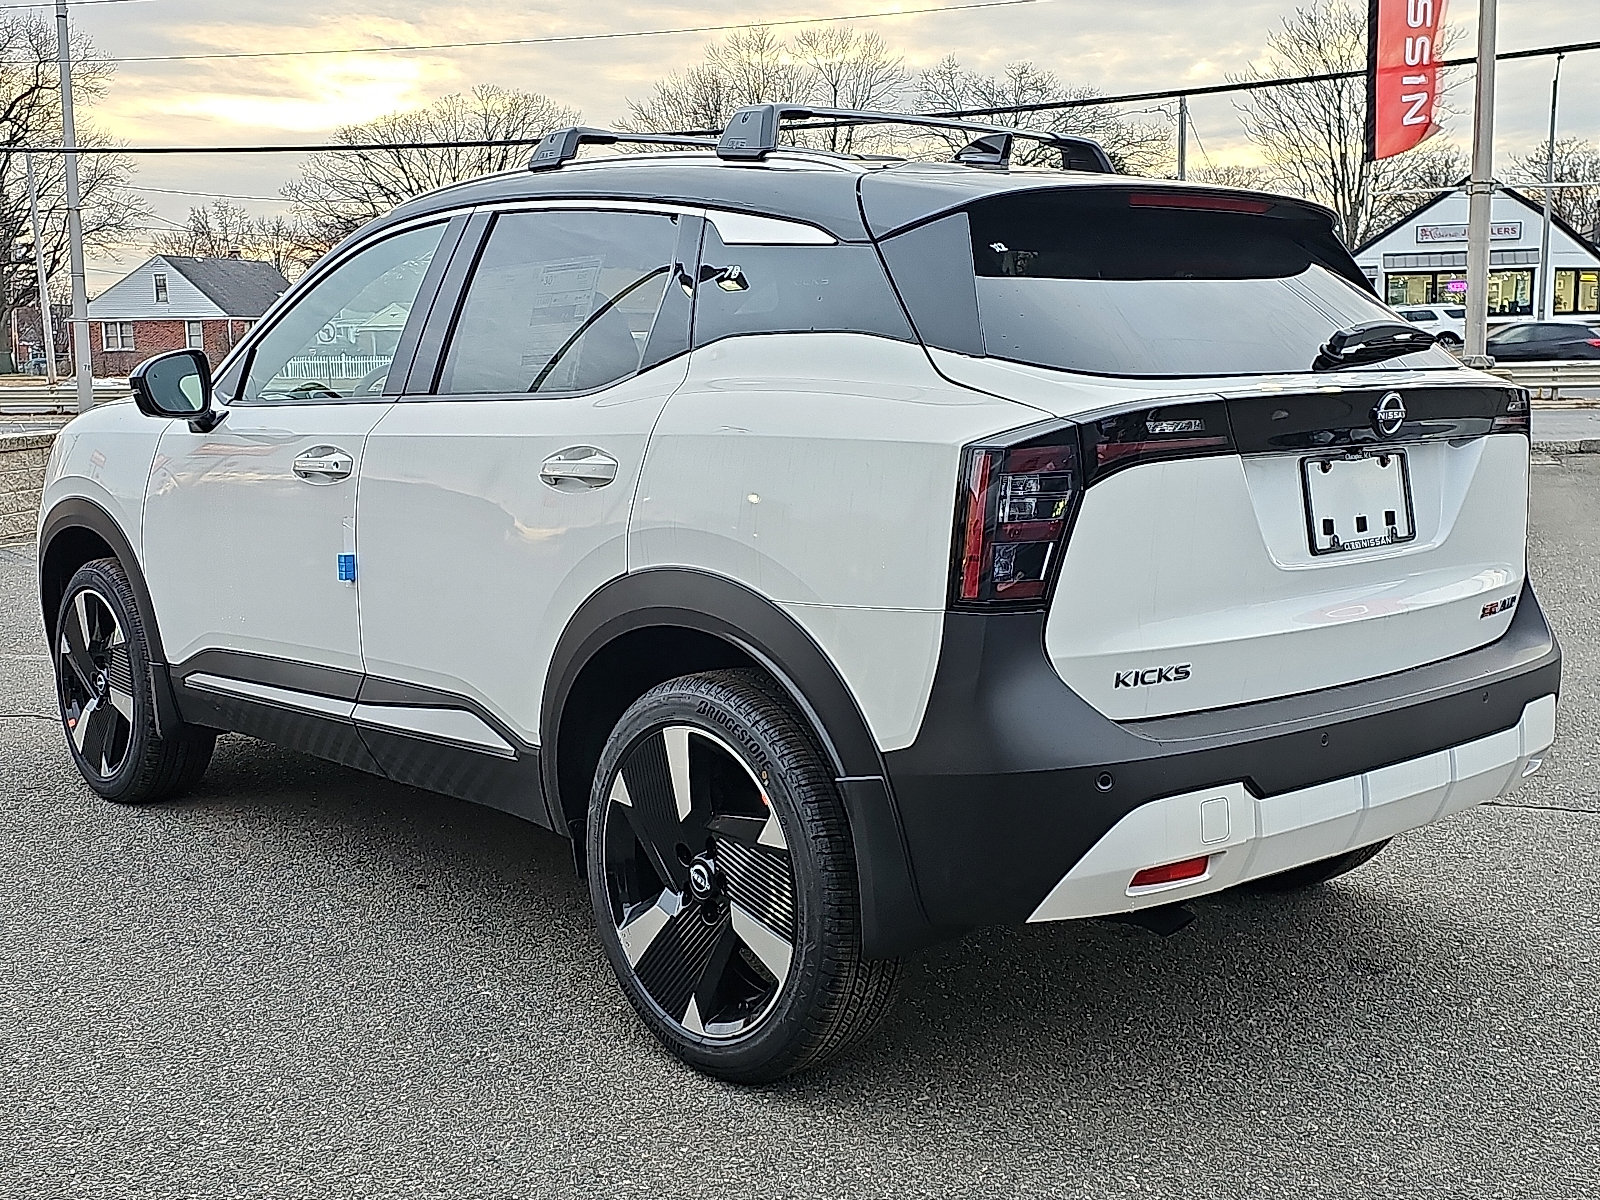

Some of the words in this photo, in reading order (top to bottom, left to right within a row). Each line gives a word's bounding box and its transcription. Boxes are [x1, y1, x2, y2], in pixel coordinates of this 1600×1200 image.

[1461, 227, 1517, 236] JLERS
[1114, 664, 1191, 688] KICKS
[696, 700, 774, 770] BRIDGESTONE
